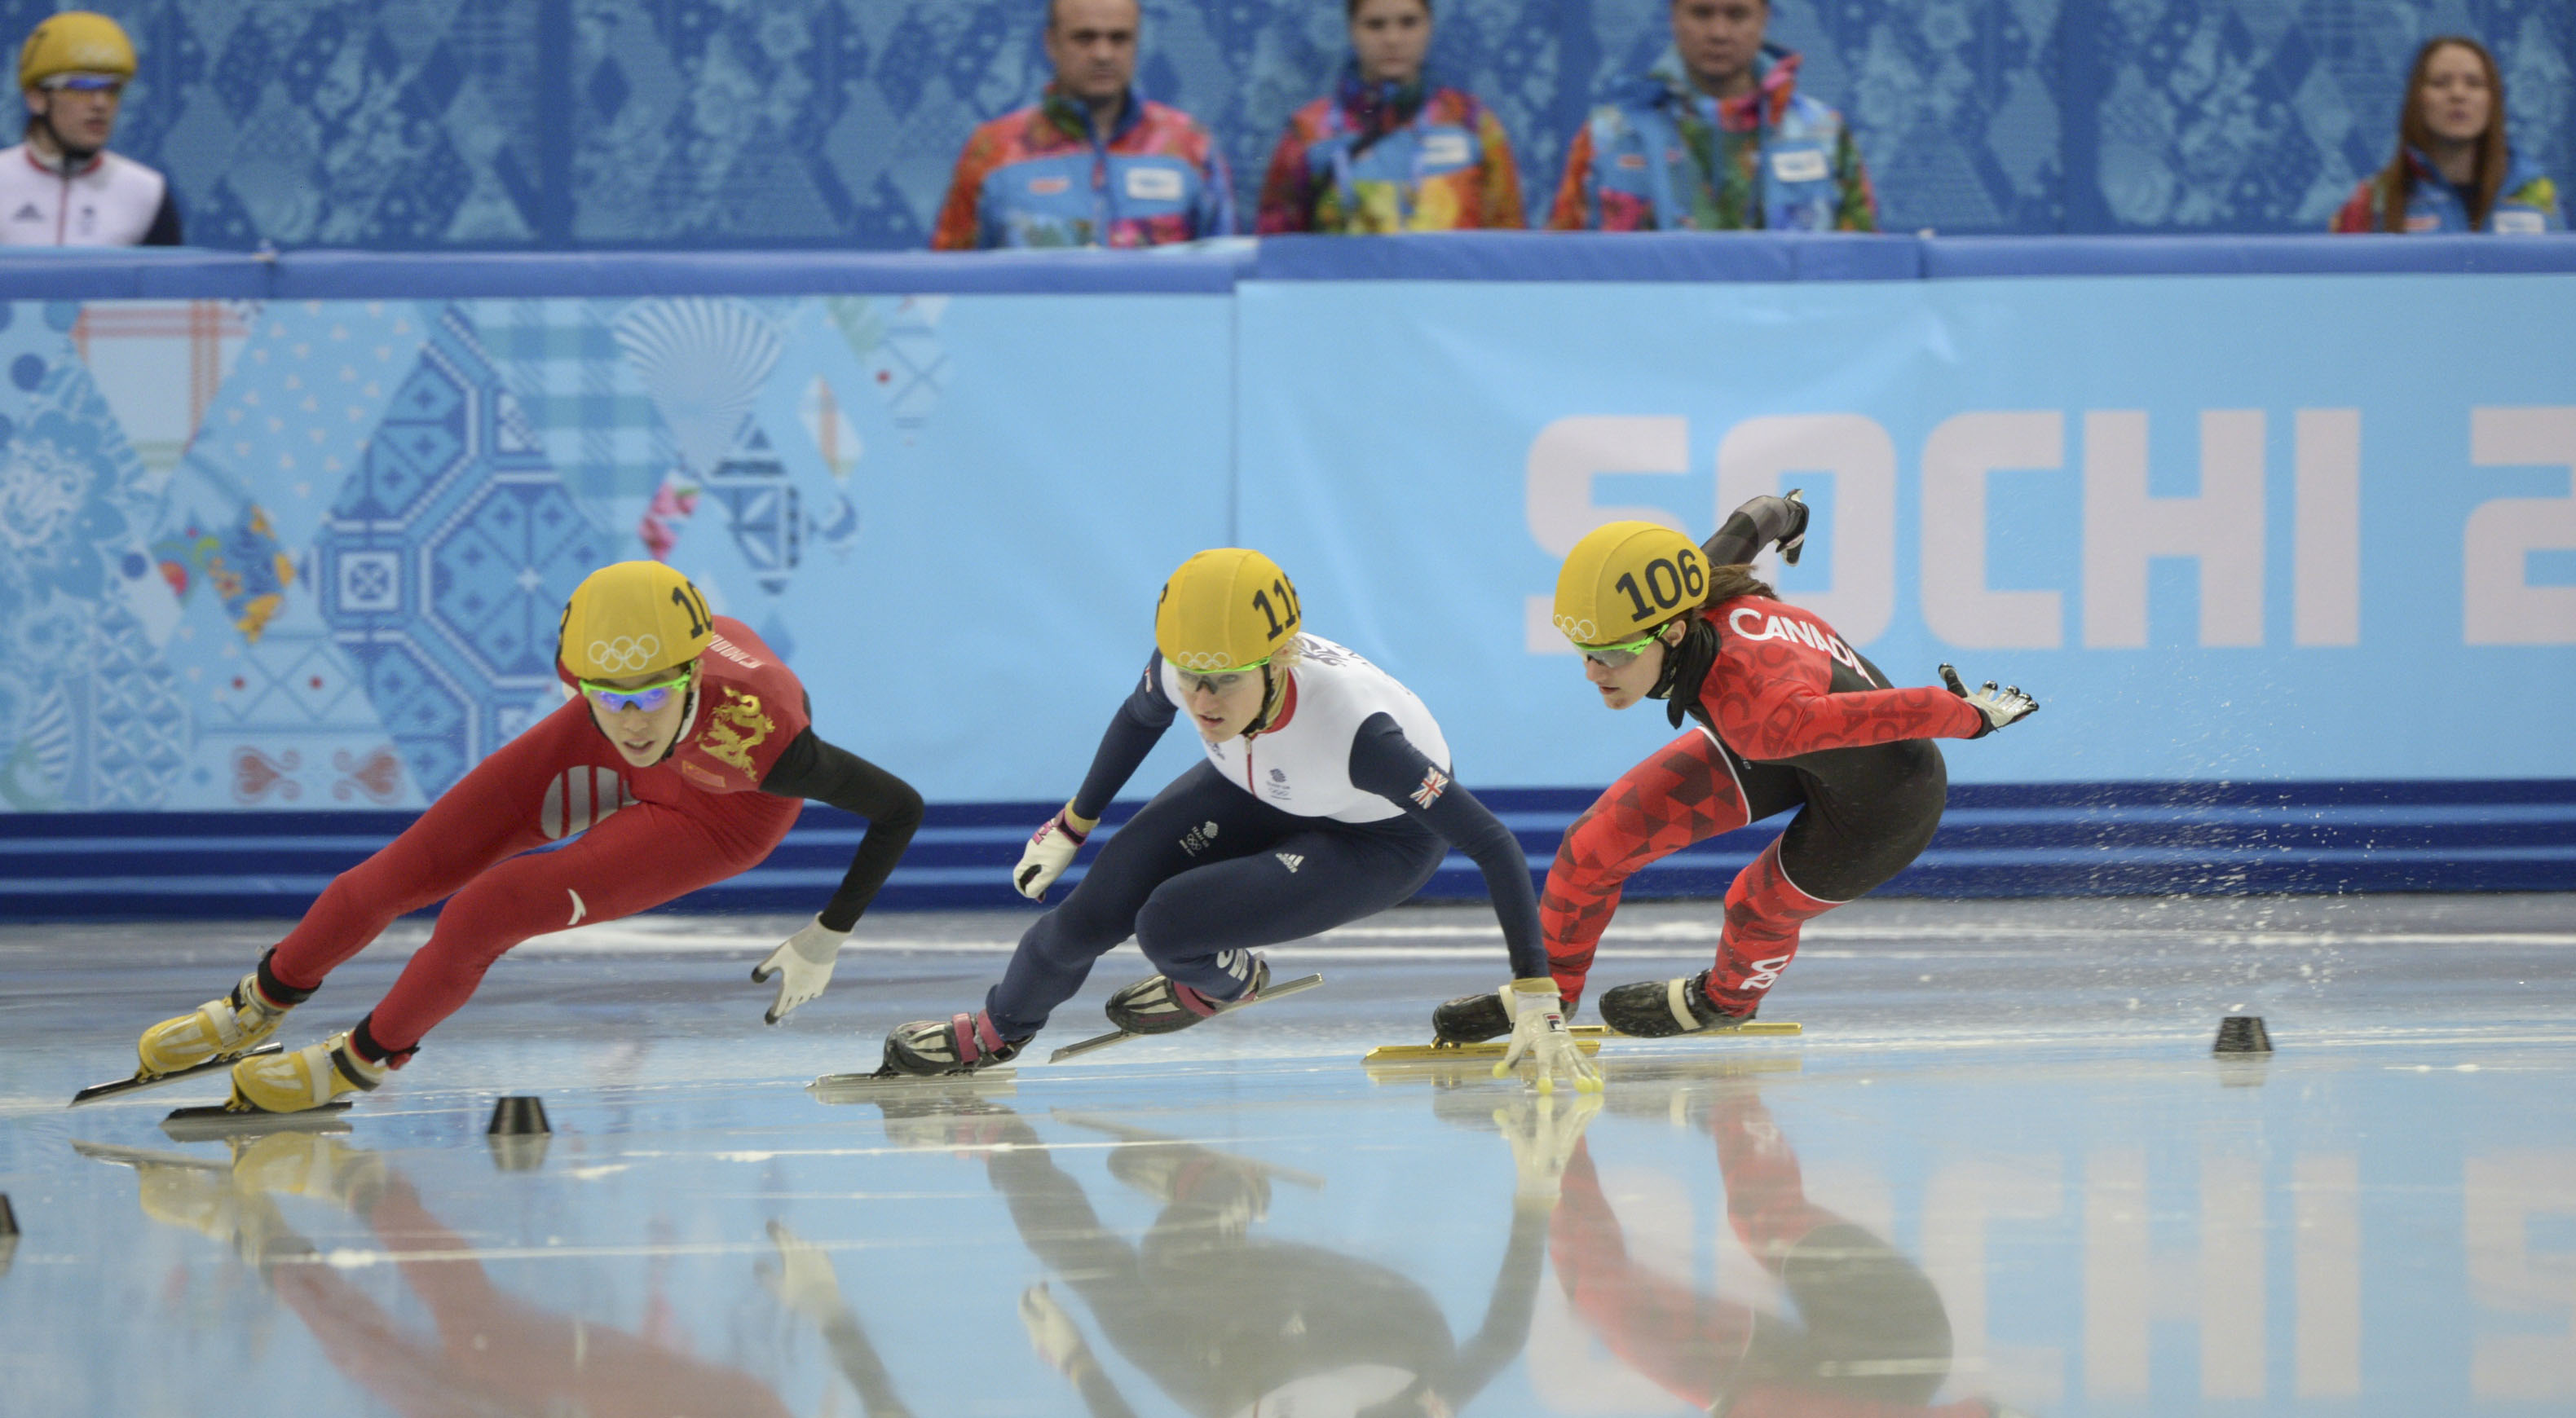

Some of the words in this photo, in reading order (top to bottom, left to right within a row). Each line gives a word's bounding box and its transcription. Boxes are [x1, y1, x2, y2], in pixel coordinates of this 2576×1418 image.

[1525, 407, 2361, 654] SOCHI
[672, 580, 712, 639] 10
[1615, 548, 1704, 623] 106
[1729, 607, 1878, 689] CANADA
